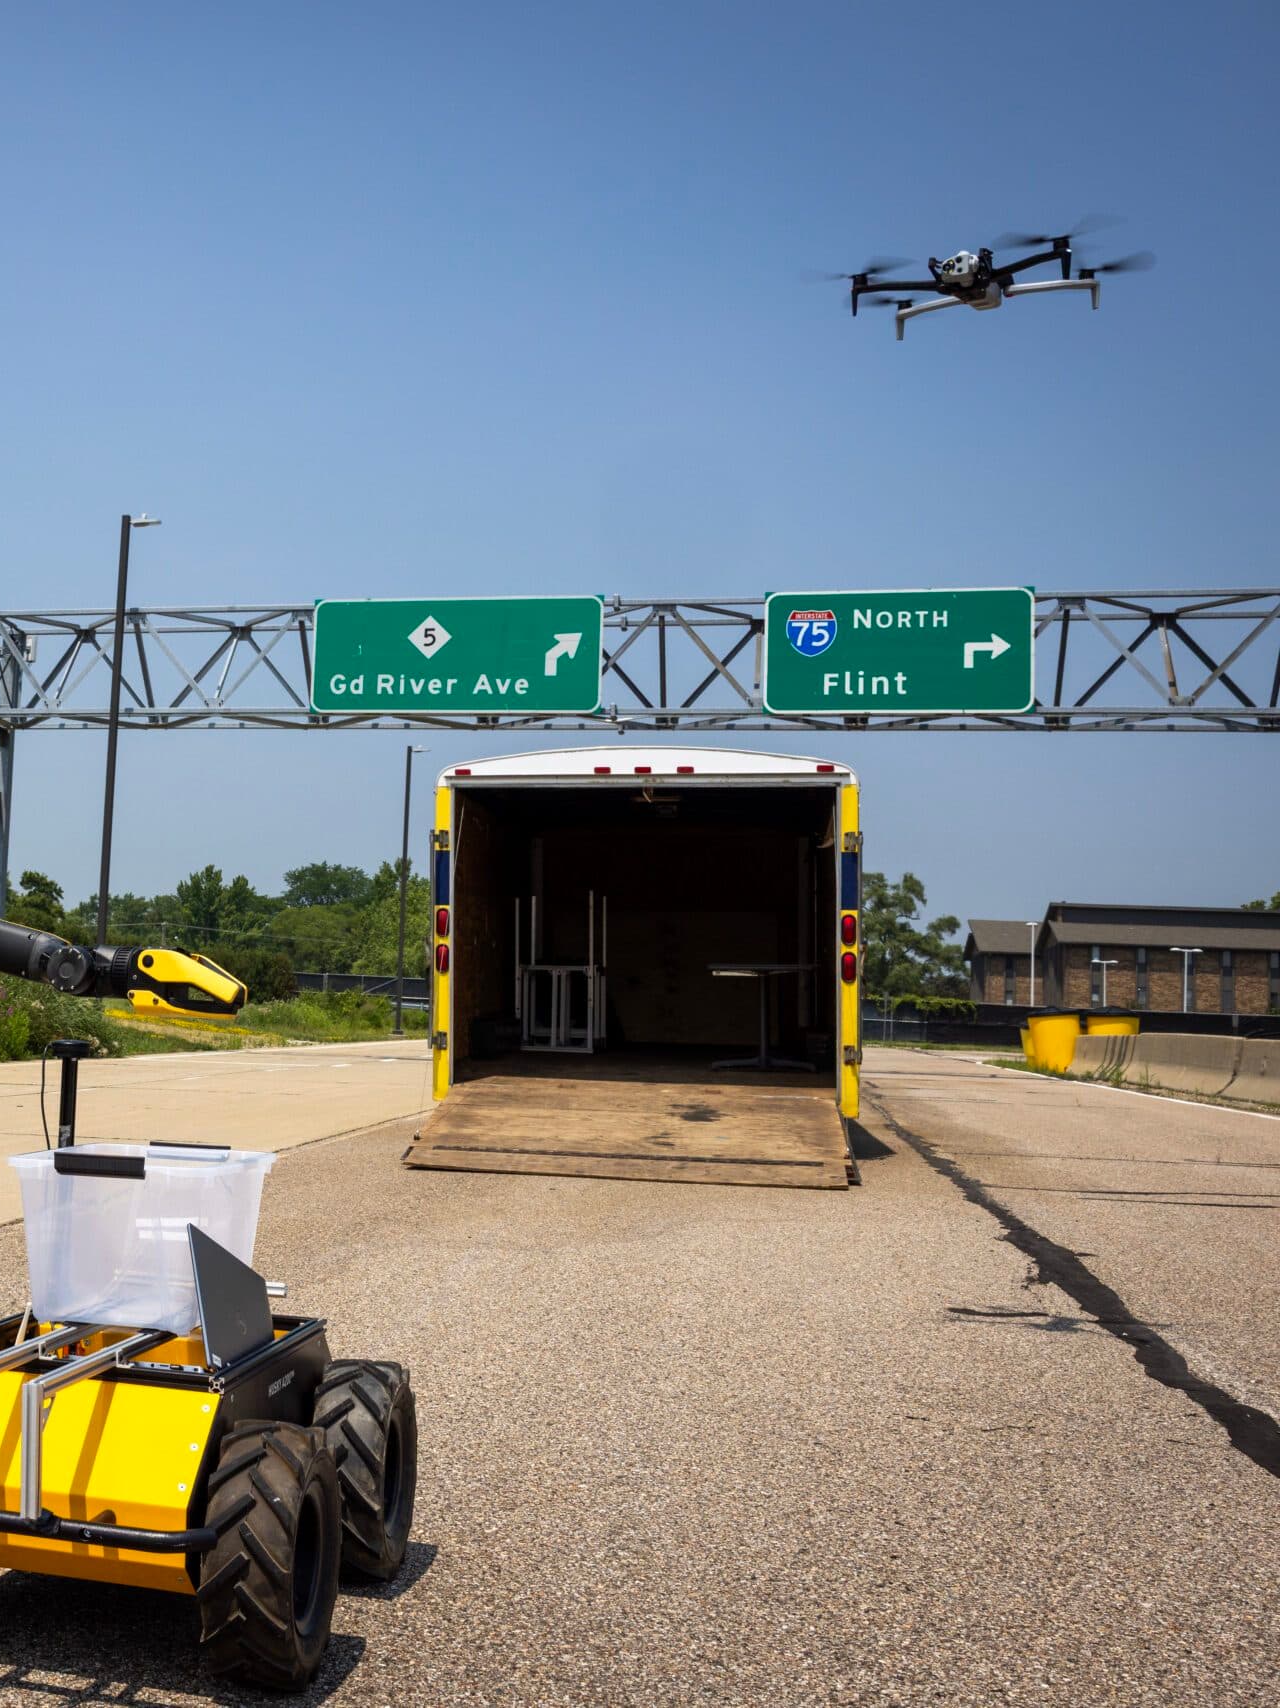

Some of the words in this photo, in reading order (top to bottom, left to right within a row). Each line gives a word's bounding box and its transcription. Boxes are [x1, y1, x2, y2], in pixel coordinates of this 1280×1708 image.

[794, 612, 828, 620] INTERSTATE
[853, 608, 948, 629] NORTH
[423, 627, 437, 647] 5
[791, 621, 830, 647] 75
[329, 673, 365, 695] Gd
[376, 673, 459, 695] River
[472, 673, 530, 695] Ave
[823, 670, 907, 695] Flint
